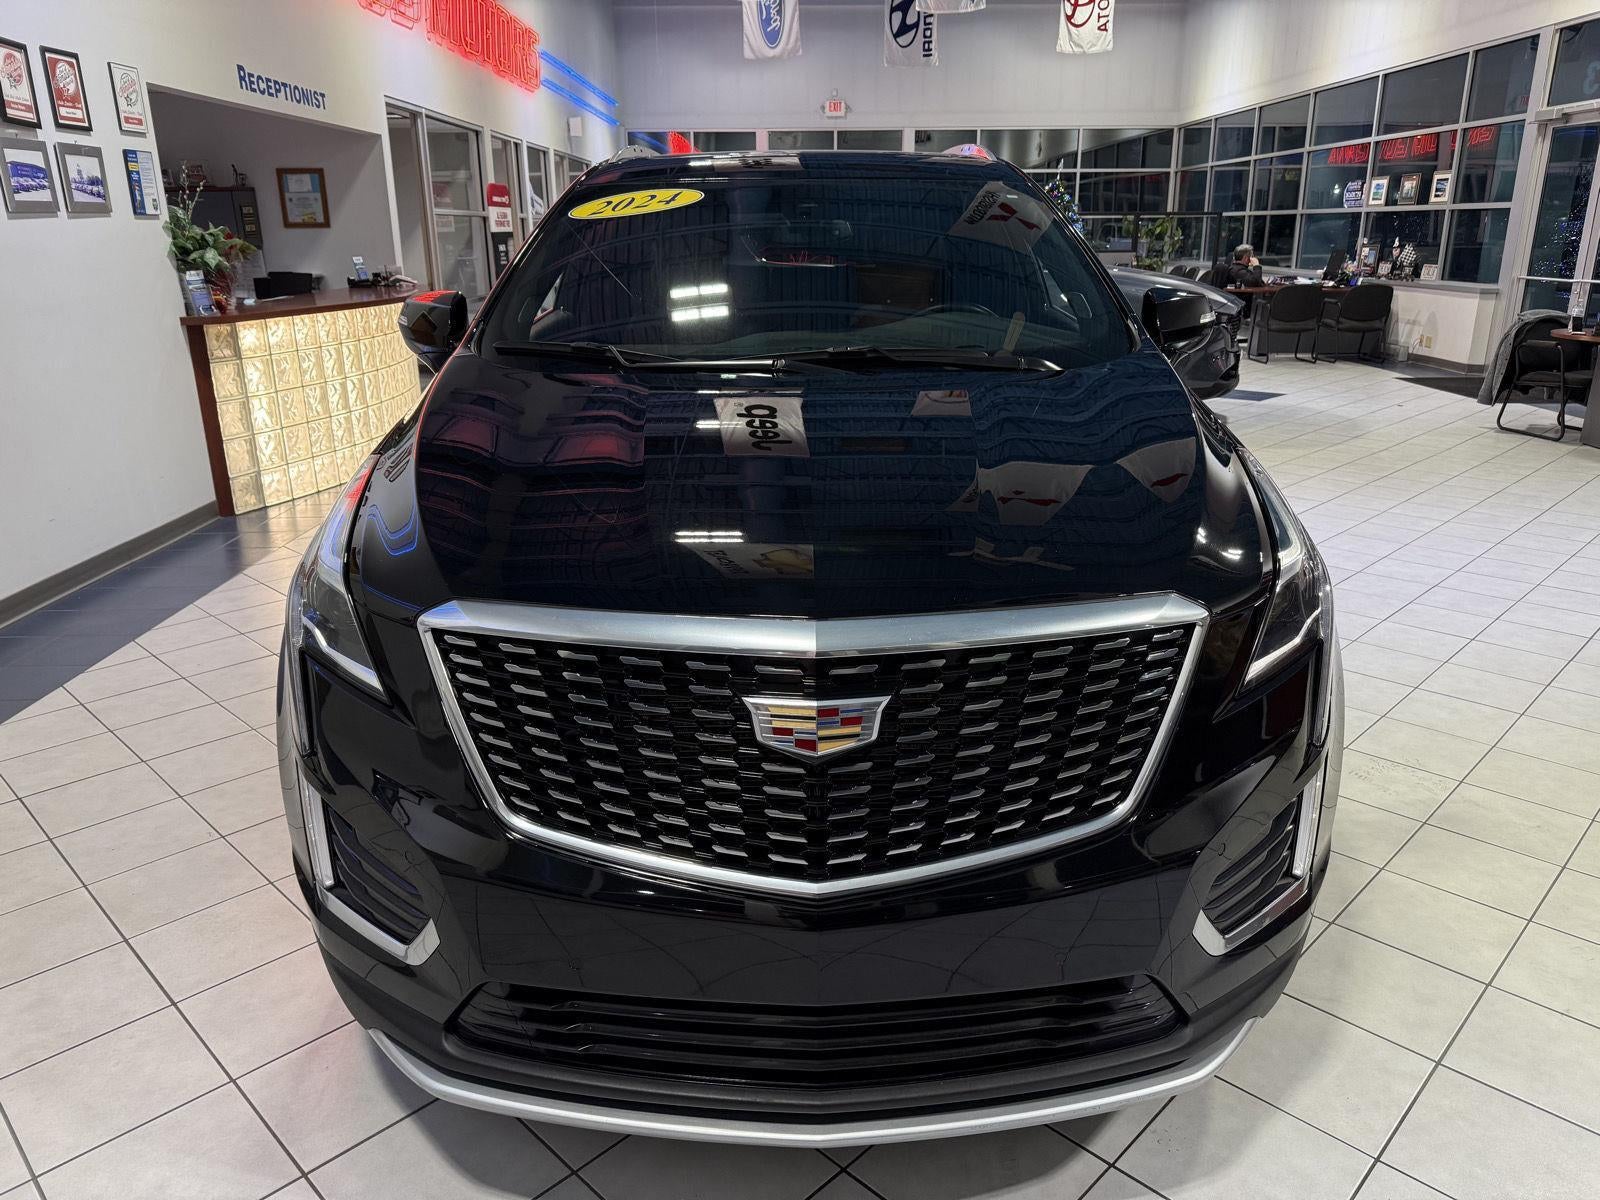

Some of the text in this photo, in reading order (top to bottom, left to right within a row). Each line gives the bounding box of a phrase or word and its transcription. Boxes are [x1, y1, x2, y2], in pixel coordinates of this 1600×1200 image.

[236, 64, 326, 110] RECEPTIONIST
[828, 101, 842, 113] EXIT
[587, 191, 683, 217] 2024
